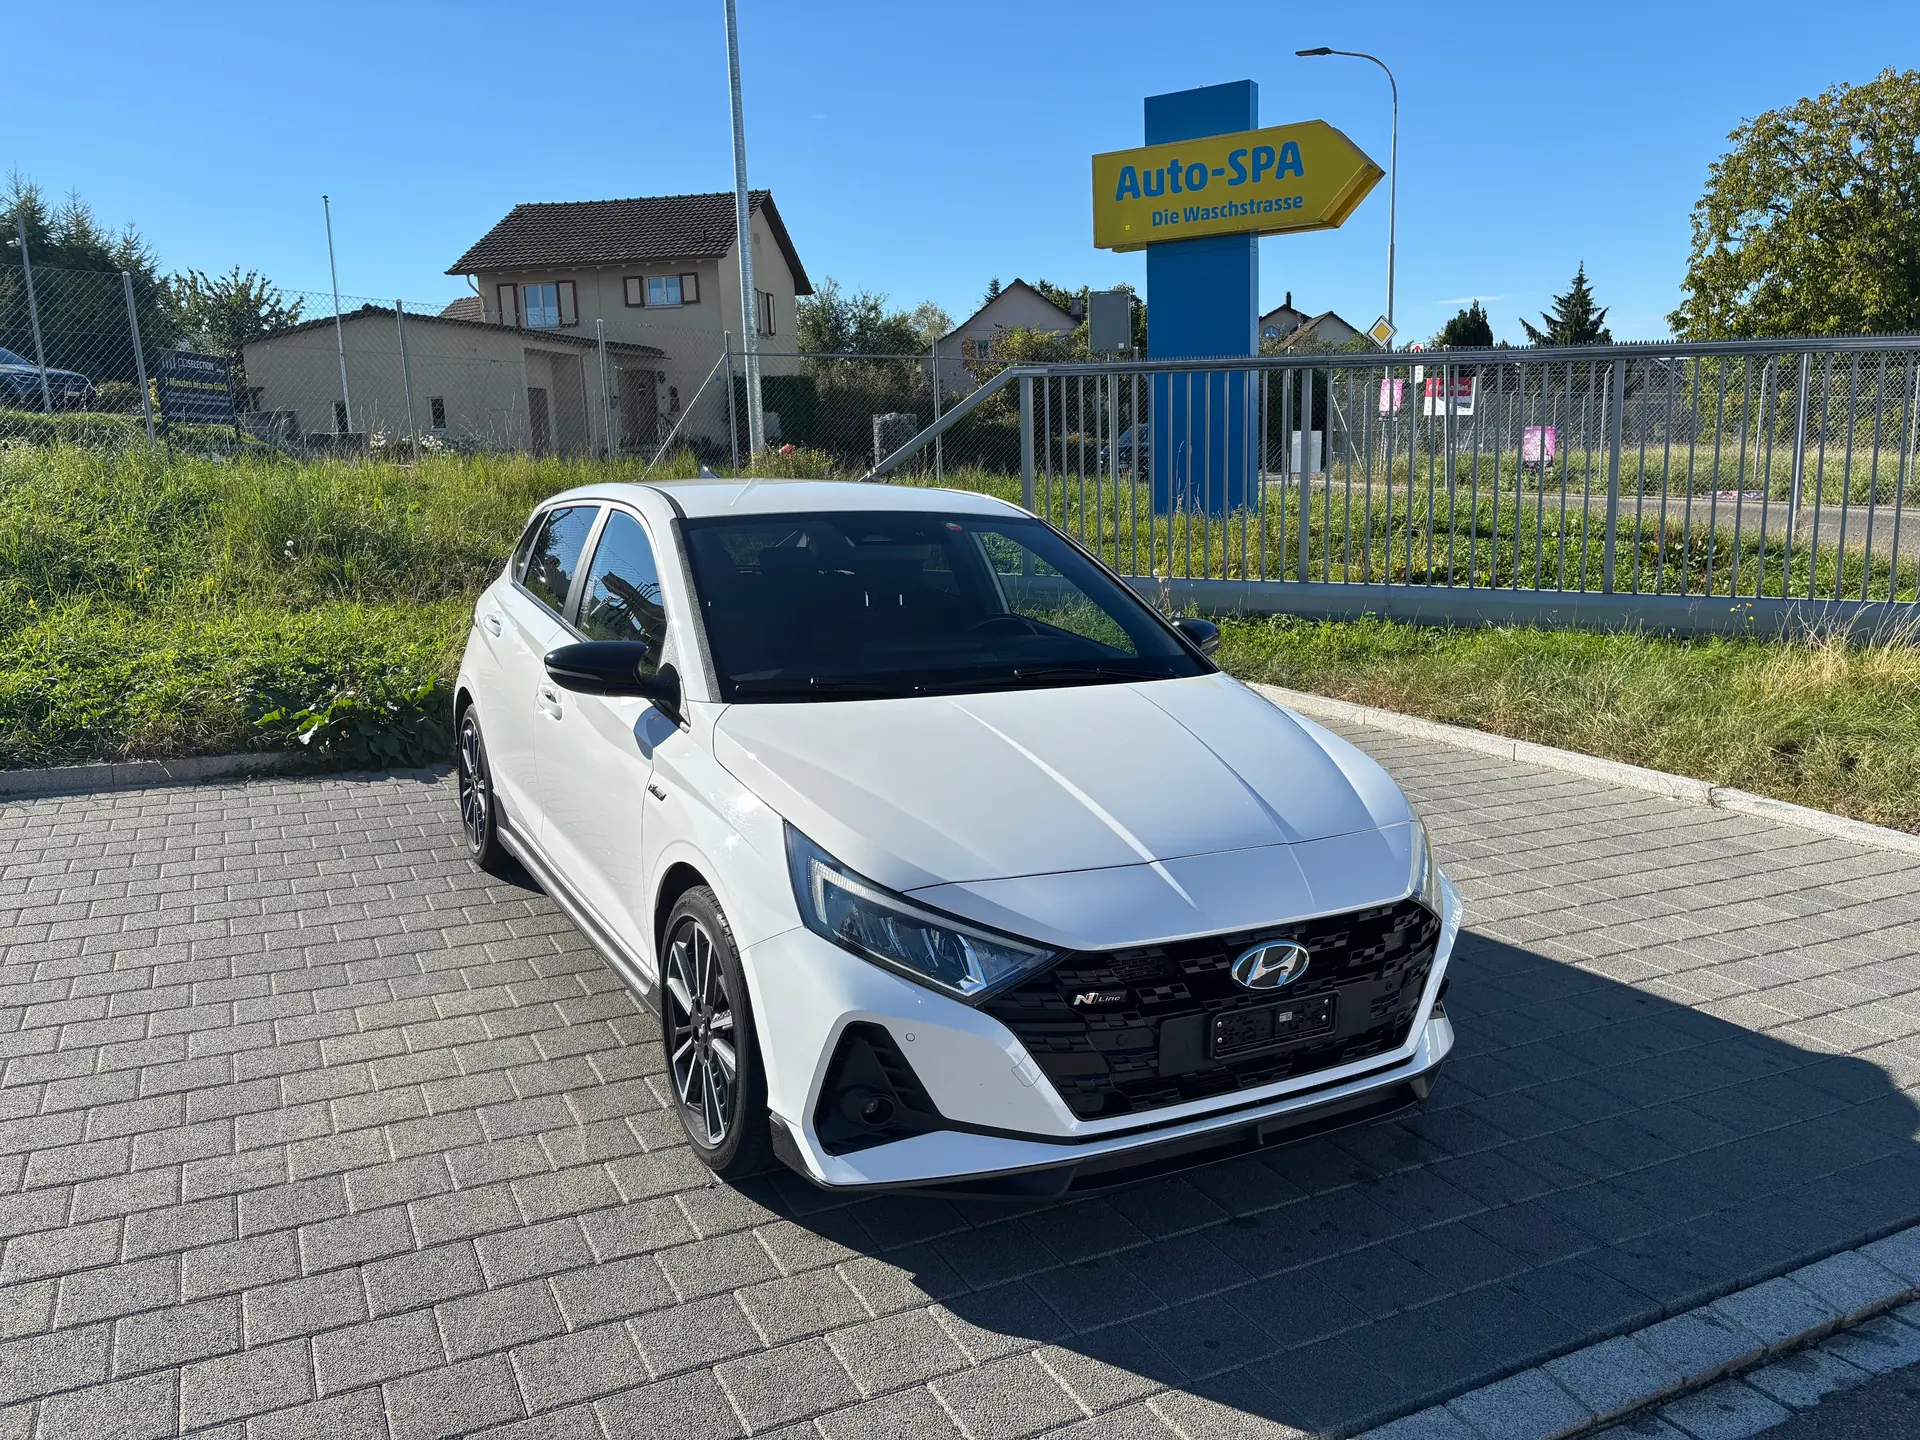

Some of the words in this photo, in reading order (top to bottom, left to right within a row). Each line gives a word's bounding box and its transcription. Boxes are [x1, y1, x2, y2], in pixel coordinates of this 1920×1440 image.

[1115, 140, 1305, 201] Auto-SPA
[1152, 208, 1180, 227] Die
[1183, 195, 1304, 222] Waschstrasse
[1098, 995, 1121, 1003] Line
